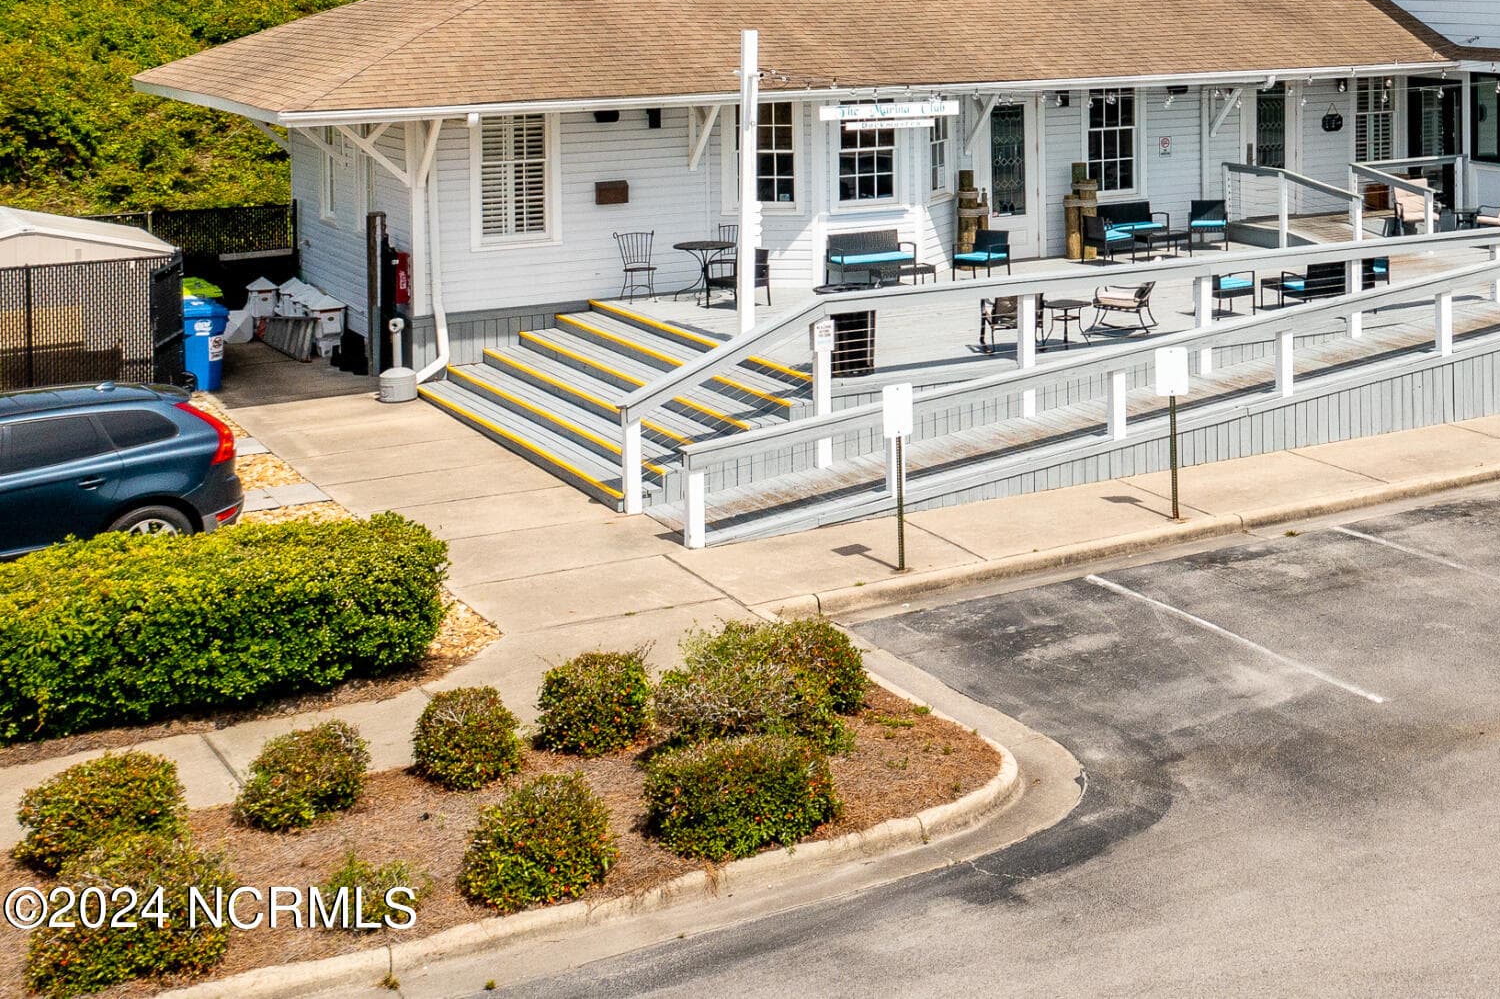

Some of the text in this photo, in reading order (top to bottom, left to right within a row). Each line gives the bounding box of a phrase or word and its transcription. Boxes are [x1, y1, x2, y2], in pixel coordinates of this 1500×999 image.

[836, 101, 945, 118] The Marina Club
